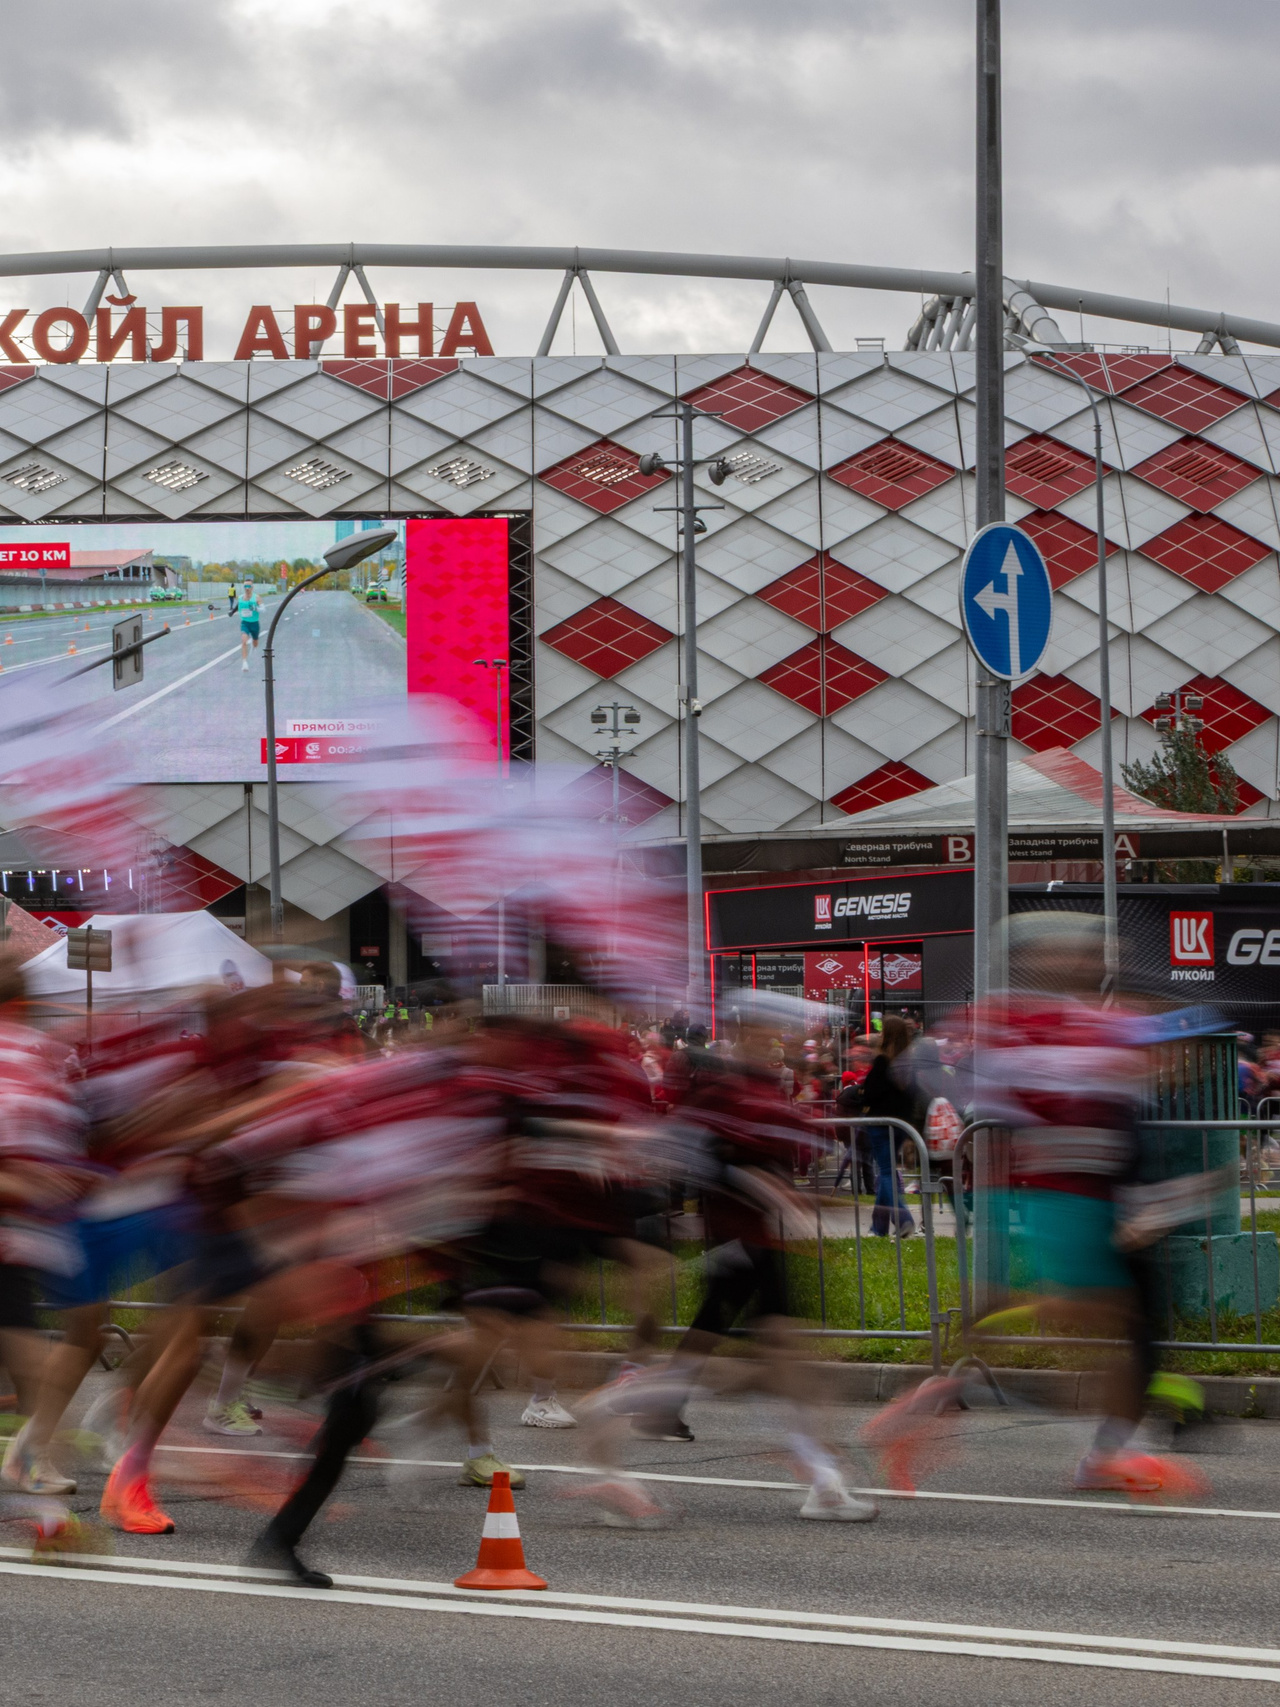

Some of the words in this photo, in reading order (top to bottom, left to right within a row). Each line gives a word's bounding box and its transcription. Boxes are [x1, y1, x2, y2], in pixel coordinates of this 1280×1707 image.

[234, 302, 495, 361] АРЕНА
[20, 551, 39, 561] 10
[43, 550, 66, 561] КМ
[293, 721, 345, 732] ПРЯМОЙ
[892, 842, 933, 852] трибуна
[1008, 839, 1056, 847] Западная
[1058, 838, 1099, 847] трибуна
[1114, 834, 1137, 858] A
[948, 837, 972, 862] B
[833, 892, 912, 917] GENESIS
[1170, 969, 1215, 980] ЛУКОЙЛ
